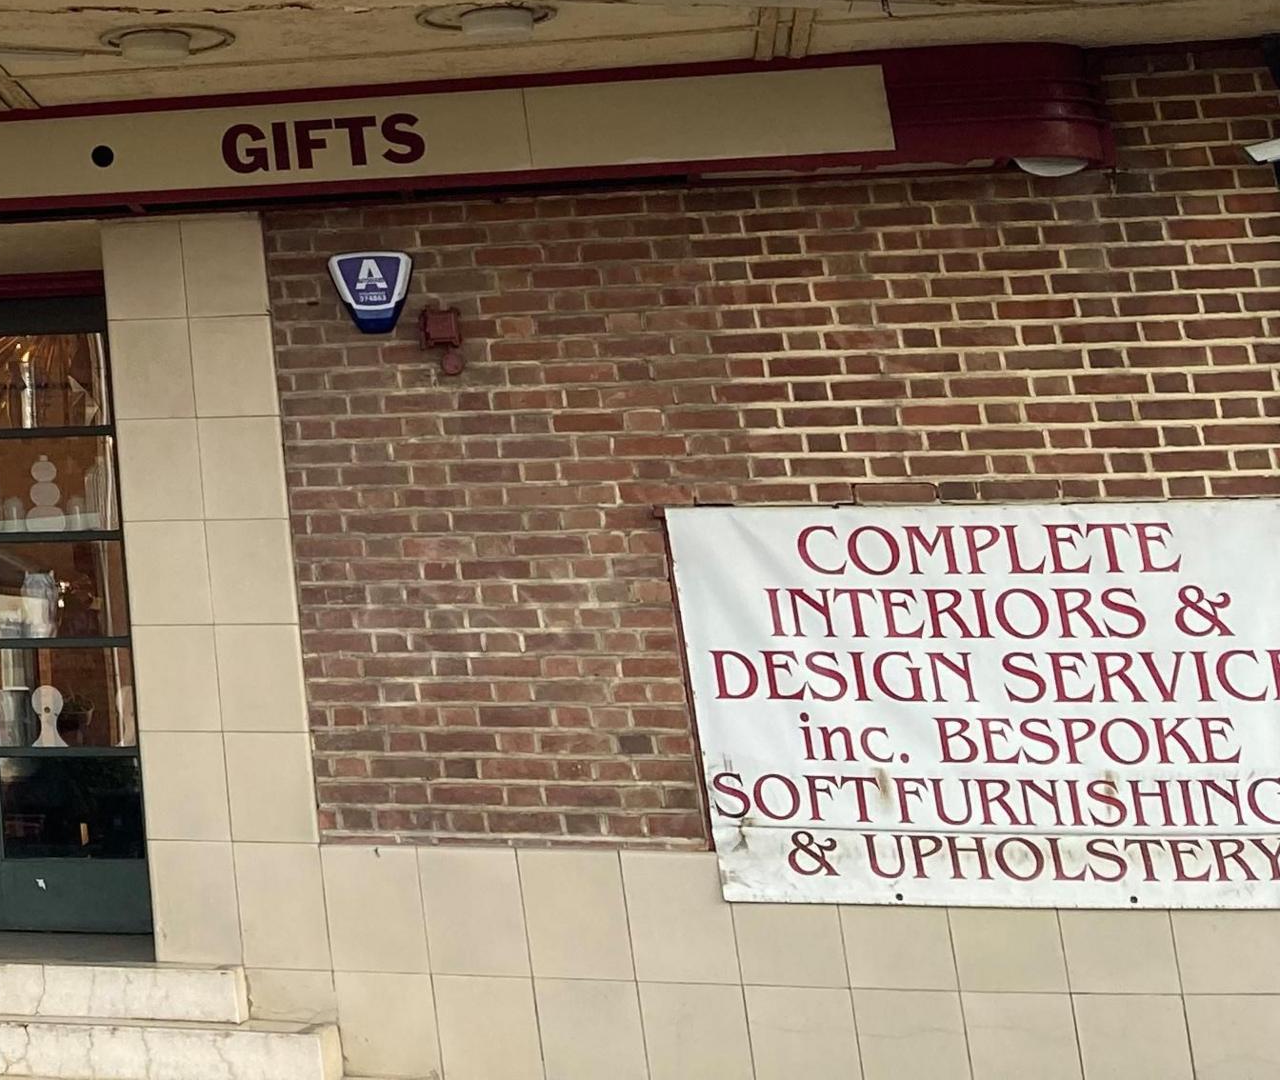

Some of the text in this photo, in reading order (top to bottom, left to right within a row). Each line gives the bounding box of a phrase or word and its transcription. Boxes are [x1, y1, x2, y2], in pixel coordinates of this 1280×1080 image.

[221, 113, 426, 174] GIFTS
[796, 522, 1182, 576] COMPLETE
[764, 585, 1235, 640] INTERIORS &
[709, 649, 980, 703] DESIGN
[800, 712, 1242, 766] inc. BESPOKE
[712, 772, 883, 823] SOFT
[788, 830, 1280, 882] & UPHOLSTERY
